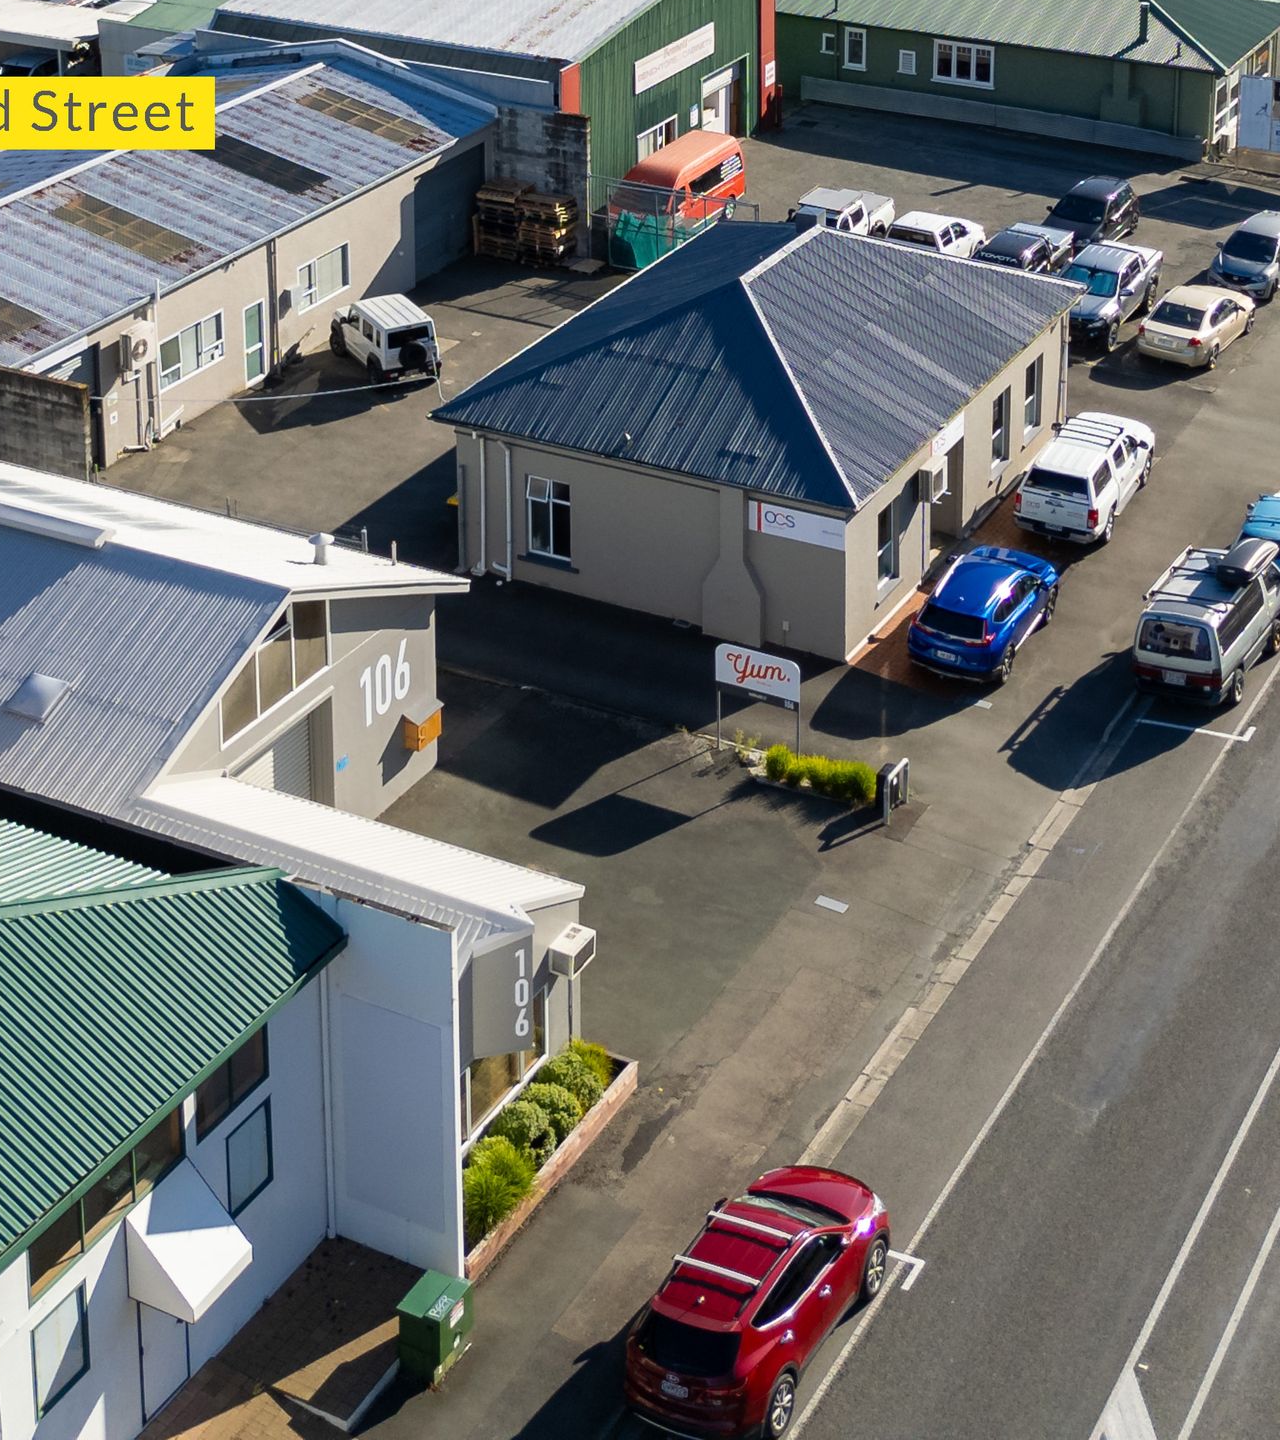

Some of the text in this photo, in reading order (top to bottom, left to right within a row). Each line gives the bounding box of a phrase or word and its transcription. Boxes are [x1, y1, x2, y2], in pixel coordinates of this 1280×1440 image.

[980, 251, 1018, 264] TOYOTA
[764, 510, 795, 528] OCS
[359, 637, 411, 728] 106
[726, 652, 791, 684] Yum.
[514, 948, 530, 1037] 106
